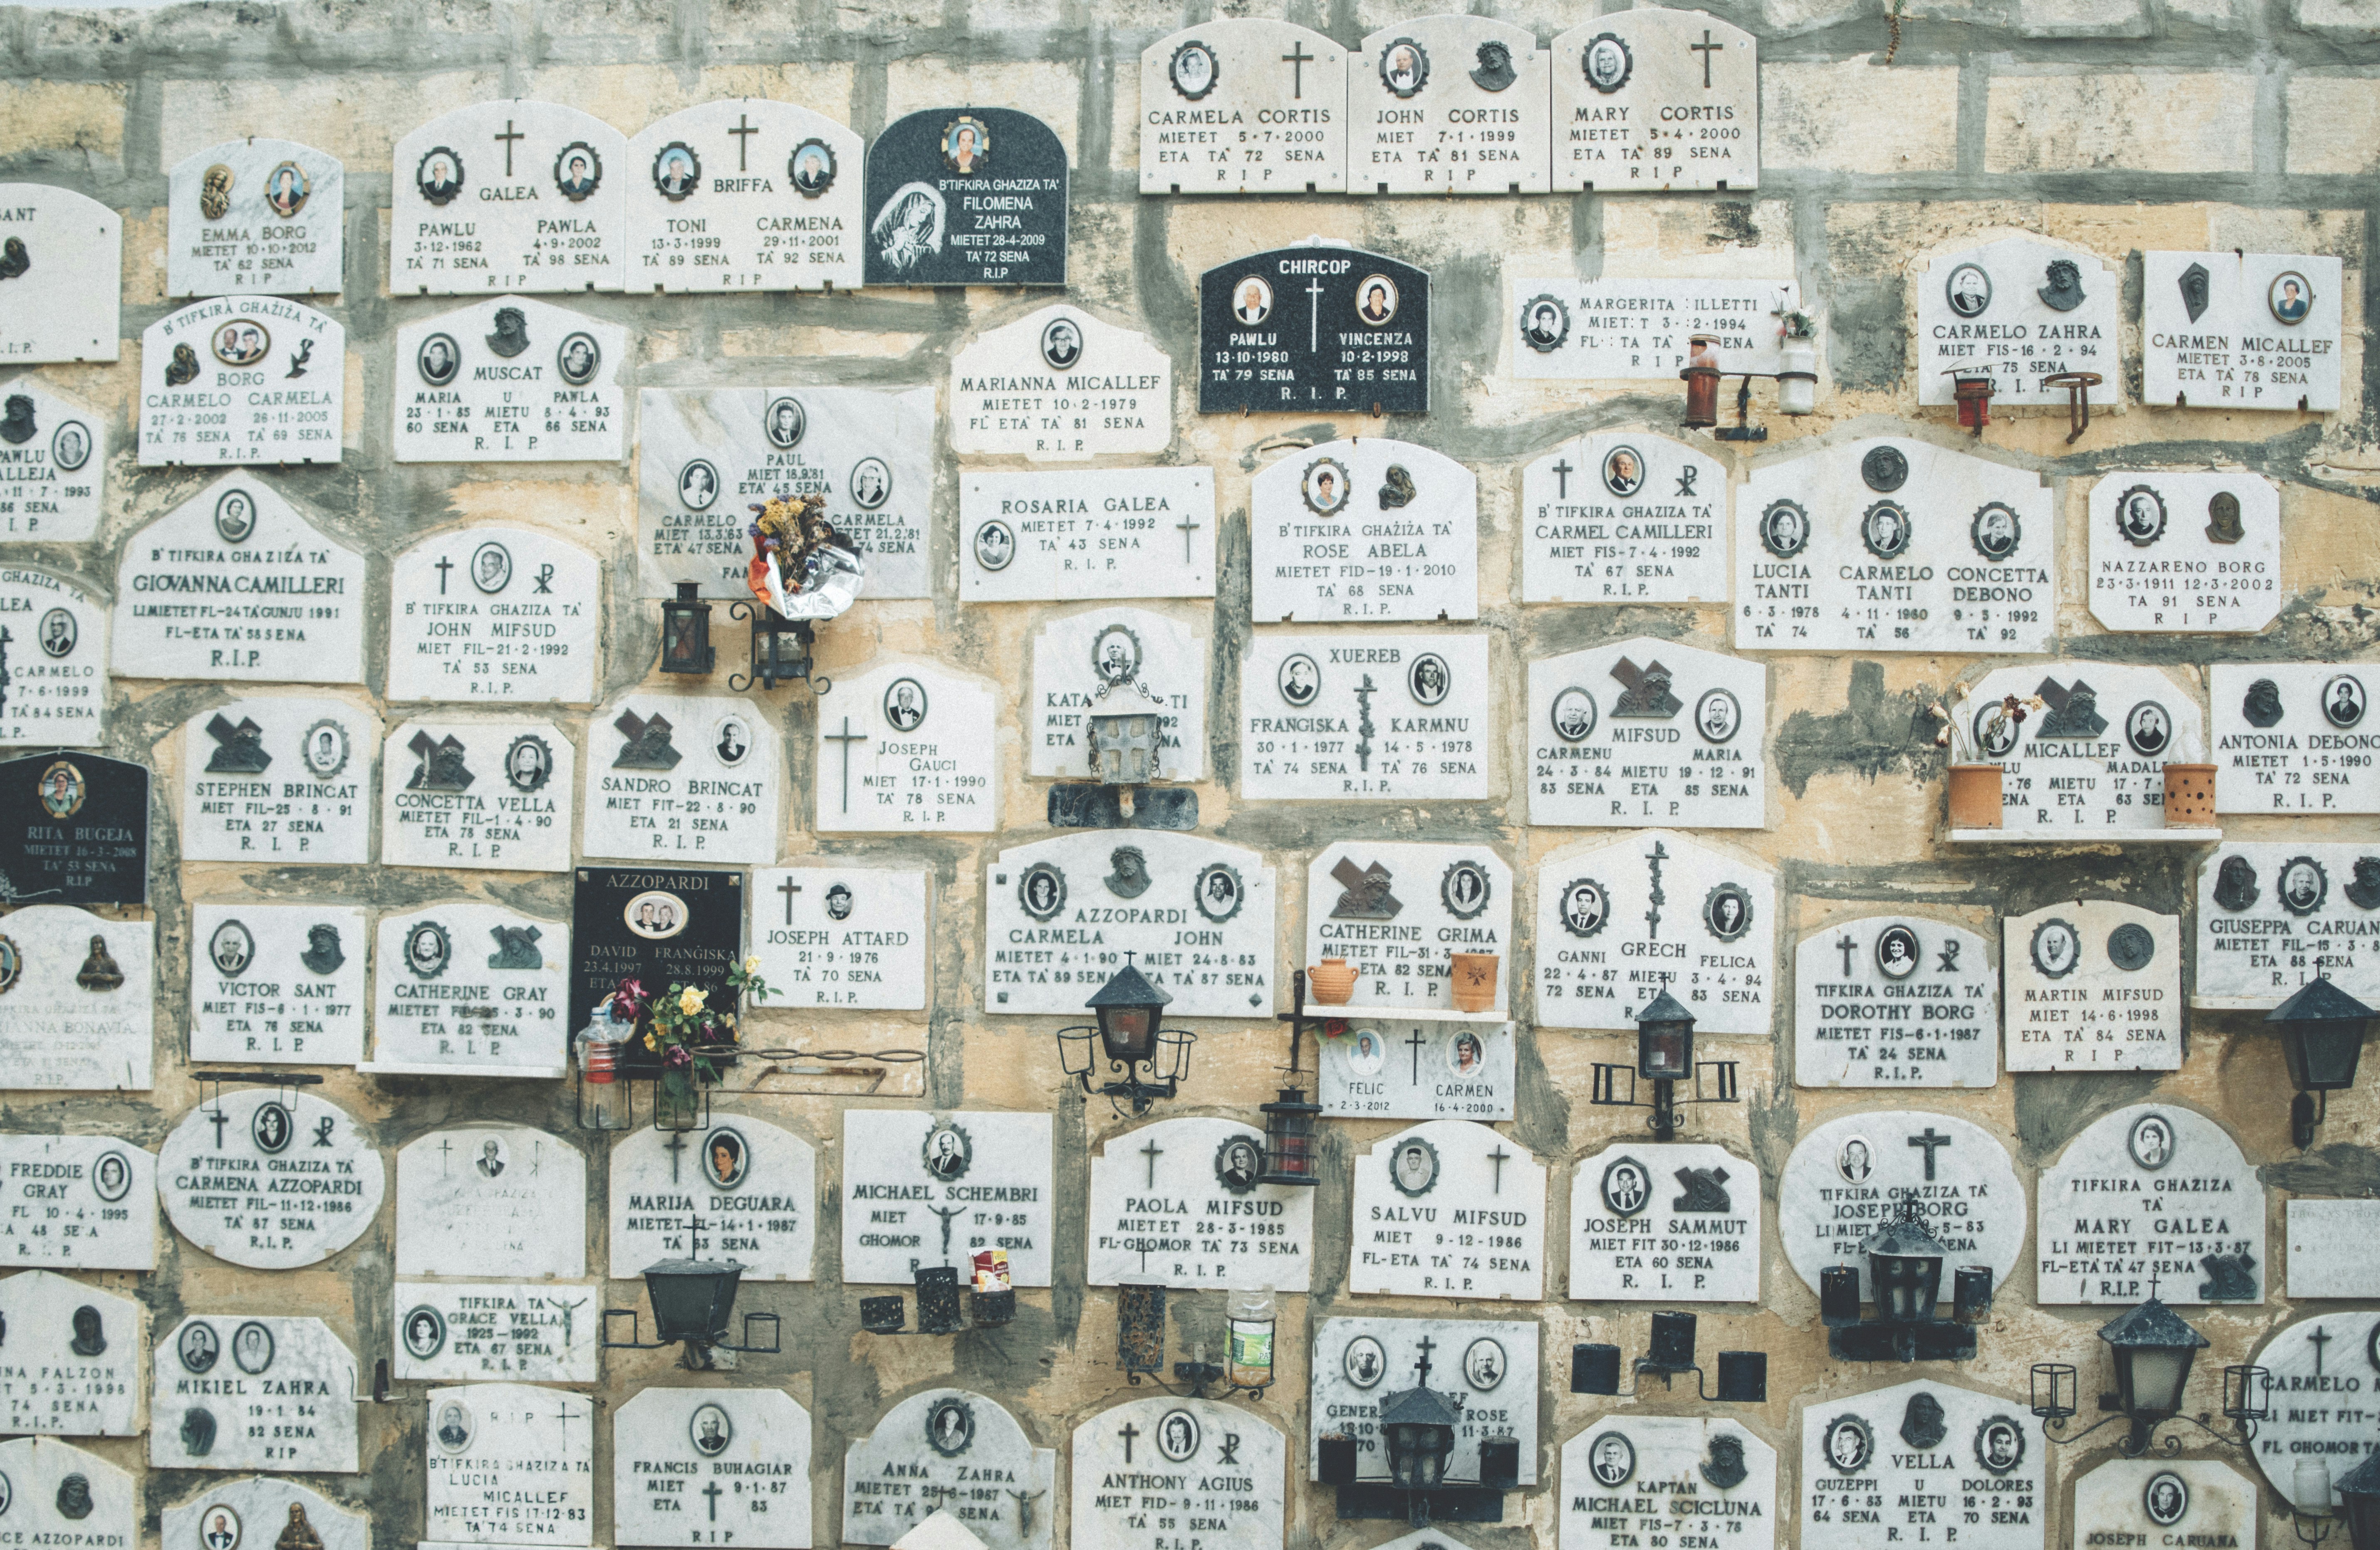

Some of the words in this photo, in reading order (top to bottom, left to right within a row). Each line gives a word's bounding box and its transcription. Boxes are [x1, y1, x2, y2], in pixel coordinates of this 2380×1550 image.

[1148, 109, 1244, 125] CARMELA
[1257, 109, 1330, 124] CORTIS
[1377, 109, 1424, 124] JOHN
[1448, 108, 1519, 124] CORTIS
[1575, 107, 1629, 122] MARY
[1660, 105, 1734, 121] CORTIS
[714, 178, 773, 193] BRIFFA
[993, 179, 1041, 191] GHAZIZA
[479, 186, 539, 201] GALEA
[963, 196, 1033, 210] FILOMENA
[419, 222, 476, 237] PAWLU
[537, 219, 597, 234] PAWLA
[666, 218, 706, 233] TONI
[756, 217, 843, 231] CARMENA
[974, 215, 1022, 230] ZAHRA
[202, 228, 250, 242] EMMA
[262, 225, 306, 241] BORG
[950, 234, 991, 246] MIETET
[992, 234, 1045, 246] 28-4-2009
[984, 250, 997, 263] 72
[999, 250, 1030, 262] SENA
[1279, 259, 1351, 275] CHIRCOP
[1580, 298, 1675, 311] MARGERITA
[1339, 332, 1412, 346] VINCENZA
[1932, 324, 2027, 339] CARMELO
[2038, 324, 2101, 339] ZAHRA
[1230, 333, 1277, 346] PAWLU
[2152, 333, 2228, 350] CARMEN
[2241, 337, 2333, 355] MICALLEF
[216, 372, 265, 387] BORG
[473, 366, 542, 381] MUSCAT
[960, 376, 1056, 391] MARIANNA
[1066, 375, 1161, 391] MICALLEF
[146, 393, 231, 408] CARMELO
[248, 391, 332, 406] CARMELA
[415, 392, 461, 403] MARIA
[554, 391, 599, 403] PAWLA
[767, 452, 805, 466] PAUL
[1001, 499, 1088, 514] ROSARIA
[1104, 497, 1170, 512] GALEA
[662, 514, 736, 528] CARMELO
[828, 514, 904, 530] CARMELA
[1535, 525, 1610, 540] CARMEL
[1615, 524, 1712, 540] CAMILLERI
[1303, 544, 1349, 559] ROSE
[1367, 543, 1427, 559] ABELA
[1753, 564, 1812, 579] LUCIA
[1839, 565, 1934, 581] CARMELO
[1947, 567, 2049, 583] CONCETTA
[2103, 561, 2207, 573] NAZZARENO
[2218, 561, 2265, 574] BORG
[133, 574, 232, 593] GIOVANNA
[234, 576, 344, 595] CAMILLERI
[1755, 583, 1808, 599] TANTI
[1857, 585, 1912, 601] TANTI
[1953, 586, 2033, 602] DEBONO
[427, 622, 471, 637] JOHN
[491, 623, 556, 638] MIFSUD
[1330, 648, 1401, 664] XUEREB
[14, 665, 94, 678] CARMELO
[1251, 717, 1349, 734] FRANGISKA
[1391, 718, 1469, 733] KARMNU
[1612, 727, 1681, 743] MIFSUD
[2219, 734, 2298, 750] ANTONIA
[1536, 746, 1612, 760] CARMENU
[1692, 748, 1742, 761] MARIA
[2024, 743, 2121, 759] MICALLEF
[196, 782, 271, 797] STEPHEN
[283, 783, 358, 798] BRINCAT
[602, 776, 671, 794] SANDRO
[688, 779, 763, 797] BRINCAT
[395, 794, 485, 810] CONCETTA
[498, 796, 556, 813] VELLA
[27, 826, 64, 840] RITA
[75, 827, 133, 841] BUGEJA
[606, 874, 709, 890] AZZOPARDI
[1075, 908, 1187, 924] AZZOPARDI
[1319, 924, 1422, 942] CATHERINE
[1437, 927, 1497, 944] GRIMA
[2209, 919, 2292, 935] GIUSEPPA
[767, 930, 829, 945] JOSEPH
[842, 931, 909, 946] ATTARD
[1009, 929, 1104, 945] CARMELA
[1174, 931, 1223, 946] JOHN
[591, 945, 637, 958] DAVID
[1557, 950, 1606, 964] GANNI
[1621, 942, 1686, 958] GRECH
[584, 960, 642, 973] 23.4.1997
[1700, 954, 1756, 969] FELICA
[666, 963, 725, 976] 28.8.1999
[218, 981, 280, 997] VICTOR
[294, 984, 336, 998] SANT
[394, 984, 490, 1001] CATHERINE
[503, 986, 547, 1002] GRAY
[2024, 989, 2088, 1002] MARTIN
[2102, 989, 2164, 1001] MIFSUD
[1821, 1004, 1912, 1021] DOROTHY
[1922, 1004, 1974, 1020] BORG
[1349, 1081, 1384, 1095] FELIC
[1436, 1084, 1493, 1098] CARMEN
[10, 1162, 83, 1180] FREDDIE
[23, 1184, 68, 1199] GRAY
[175, 1175, 259, 1192] CARMENA
[267, 1178, 362, 1196] AZZOPARDI
[852, 1184, 935, 1201] MICHAEL
[946, 1186, 1038, 1202] SCHEMBRI
[629, 1195, 695, 1211] MARIJA
[710, 1195, 796, 1212] DEGUARA
[1126, 1198, 1188, 1214] PAOLA
[1206, 1199, 1284, 1216] MIFSUD
[1371, 1206, 1437, 1223] SALVU
[1453, 1209, 1527, 1227] MIFSUD
[1584, 1219, 1651, 1234] JOSEPH
[1668, 1219, 1747, 1235] SAMMUT
[2074, 1218, 2131, 1234] MARY
[2154, 1217, 2229, 1235] GALEA
[859, 1234, 921, 1248] GHOMOR
[459, 1297, 517, 1310] TIFKIRA
[448, 1312, 497, 1325] GRACE
[509, 1312, 558, 1326] VELLA
[41, 1367, 114, 1380] FALZON
[176, 1379, 247, 1396] MIKIEL
[263, 1380, 330, 1395] ZAHRA
[52, 1400, 98, 1413] SENA
[1466, 1409, 1508, 1423] ROSE
[633, 1461, 698, 1474] FRANCIS
[713, 1462, 792, 1476] BUHAGIAR
[1891, 1452, 1955, 1470] VELLA
[1102, 1473, 1186, 1490] ANTHONY
[1198, 1476, 1253, 1493] AGIUS
[1637, 1481, 1697, 1496] KAPTAN
[1815, 1478, 1877, 1491] GUZEPPI
[1962, 1479, 2033, 1493] DOLORES
[483, 1491, 568, 1504] MICALLEF
[1572, 1496, 1658, 1514] MICHAEL
[1669, 1498, 1762, 1516] SCICLUNA
[32, 1533, 123, 1547] AZZOPARDI
[2085, 1531, 2147, 1547] JOSEPH
[2162, 1530, 2239, 1550] CARUANA
